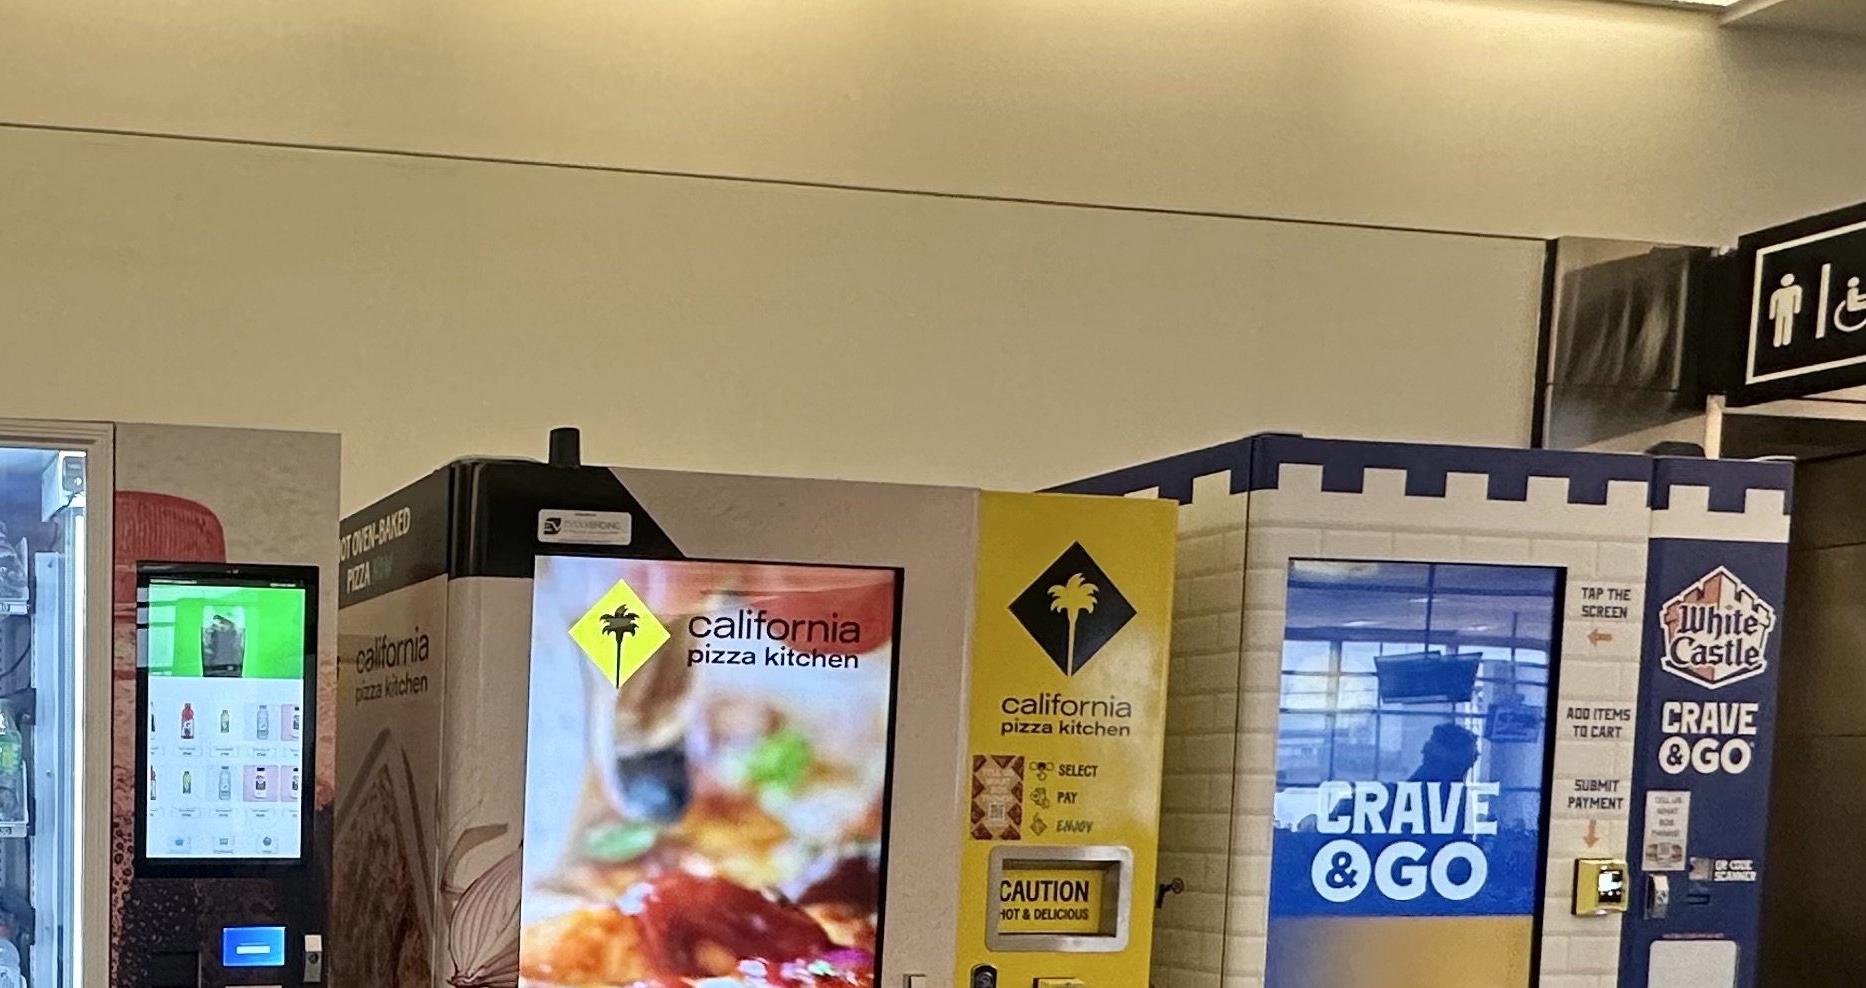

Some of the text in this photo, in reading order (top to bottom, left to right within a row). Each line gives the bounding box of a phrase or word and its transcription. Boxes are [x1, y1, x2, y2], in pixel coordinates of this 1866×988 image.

[353, 507, 410, 556] OVEN-BAKED
[347, 561, 370, 593] PIZZA
[1582, 587, 1631, 601] TAP THE
[1582, 606, 1627, 618] SCREEN
[1678, 605, 1759, 640] White
[688, 609, 860, 644] california
[356, 626, 429, 674] california
[687, 643, 858, 669] pizza kitchen
[1671, 636, 1759, 666] Castle
[355, 673, 428, 707] pizza kitchen
[1001, 693, 1132, 718] california
[1567, 708, 1630, 720] ADD ITEMS
[1000, 718, 1130, 737] pizza kitchen
[1662, 702, 1759, 735] CRAVE
[1573, 725, 1622, 738] TO CART
[1659, 736, 1752, 774] &GO
[1059, 764, 1098, 777] SELECT
[1057, 792, 1078, 804] PAY
[1574, 779, 1619, 792] SUBMIT
[1316, 781, 1500, 836] CRAVE
[1567, 797, 1624, 809] PAYMENT
[1056, 820, 1094, 833] ENJOY
[1311, 840, 1489, 902] &GO
[1000, 880, 1088, 902] CAUTION
[999, 908, 1088, 920] HOT & DELICIOUS
